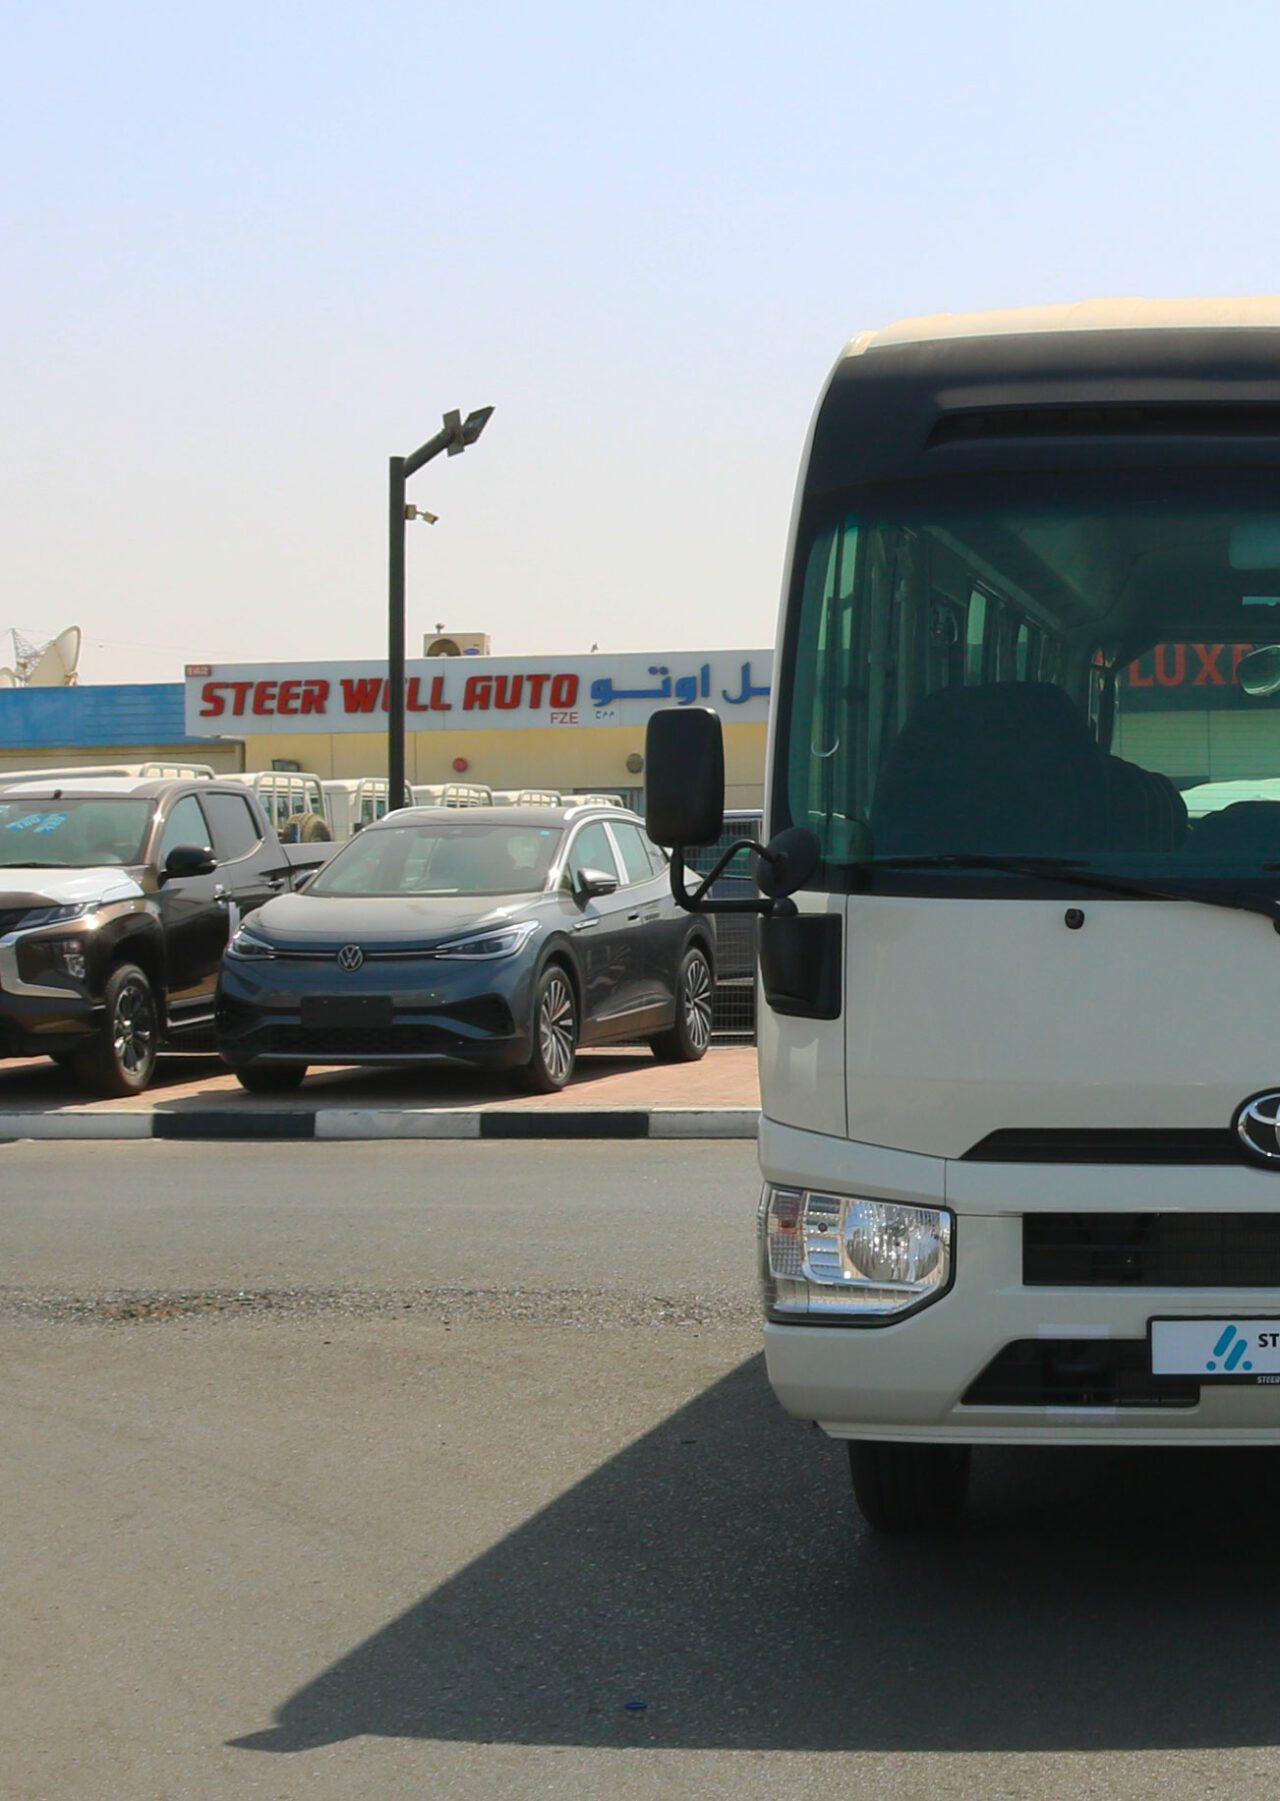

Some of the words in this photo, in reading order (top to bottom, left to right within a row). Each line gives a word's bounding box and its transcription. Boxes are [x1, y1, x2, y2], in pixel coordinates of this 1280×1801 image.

[199, 679, 330, 717] STEER
[340, 676, 452, 714] WLL
[462, 673, 580, 711] AUTO
[550, 712, 579, 725] FZE
[1256, 1375, 1280, 1384] STEER
